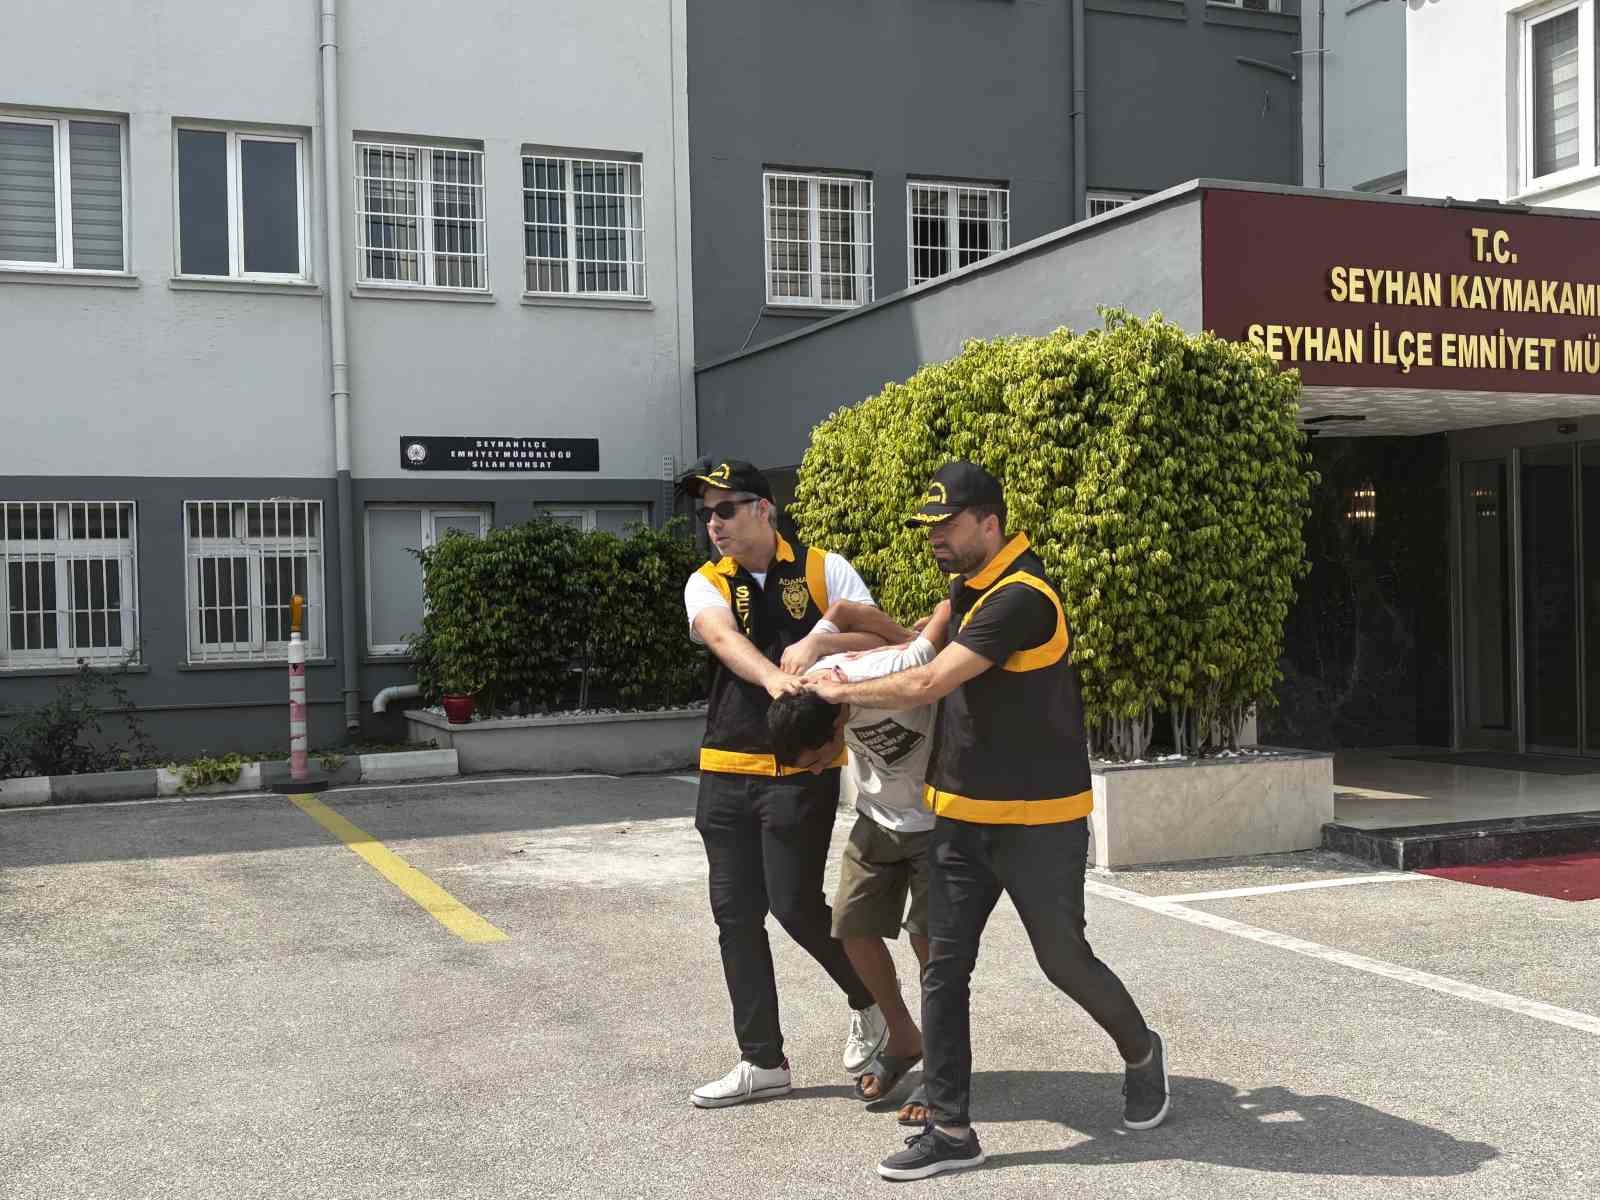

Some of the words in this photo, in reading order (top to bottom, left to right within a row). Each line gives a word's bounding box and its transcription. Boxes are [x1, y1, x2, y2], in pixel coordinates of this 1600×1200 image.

[1471, 227, 1518, 264] T.C.
[1330, 266, 1441, 307] SEYHAN
[1247, 324, 1364, 363] SEYHAN
[1373, 322, 1433, 374] İLÇE
[1441, 328, 1556, 371] EMNİYET
[1564, 333, 1600, 375] MÜ
[450, 450, 499, 458] EMNİYET
[476, 440, 519, 448] SEYHAN
[472, 460, 505, 468] SİLAH
[509, 461, 552, 469] RUHSAT
[735, 585, 750, 635] SEY
